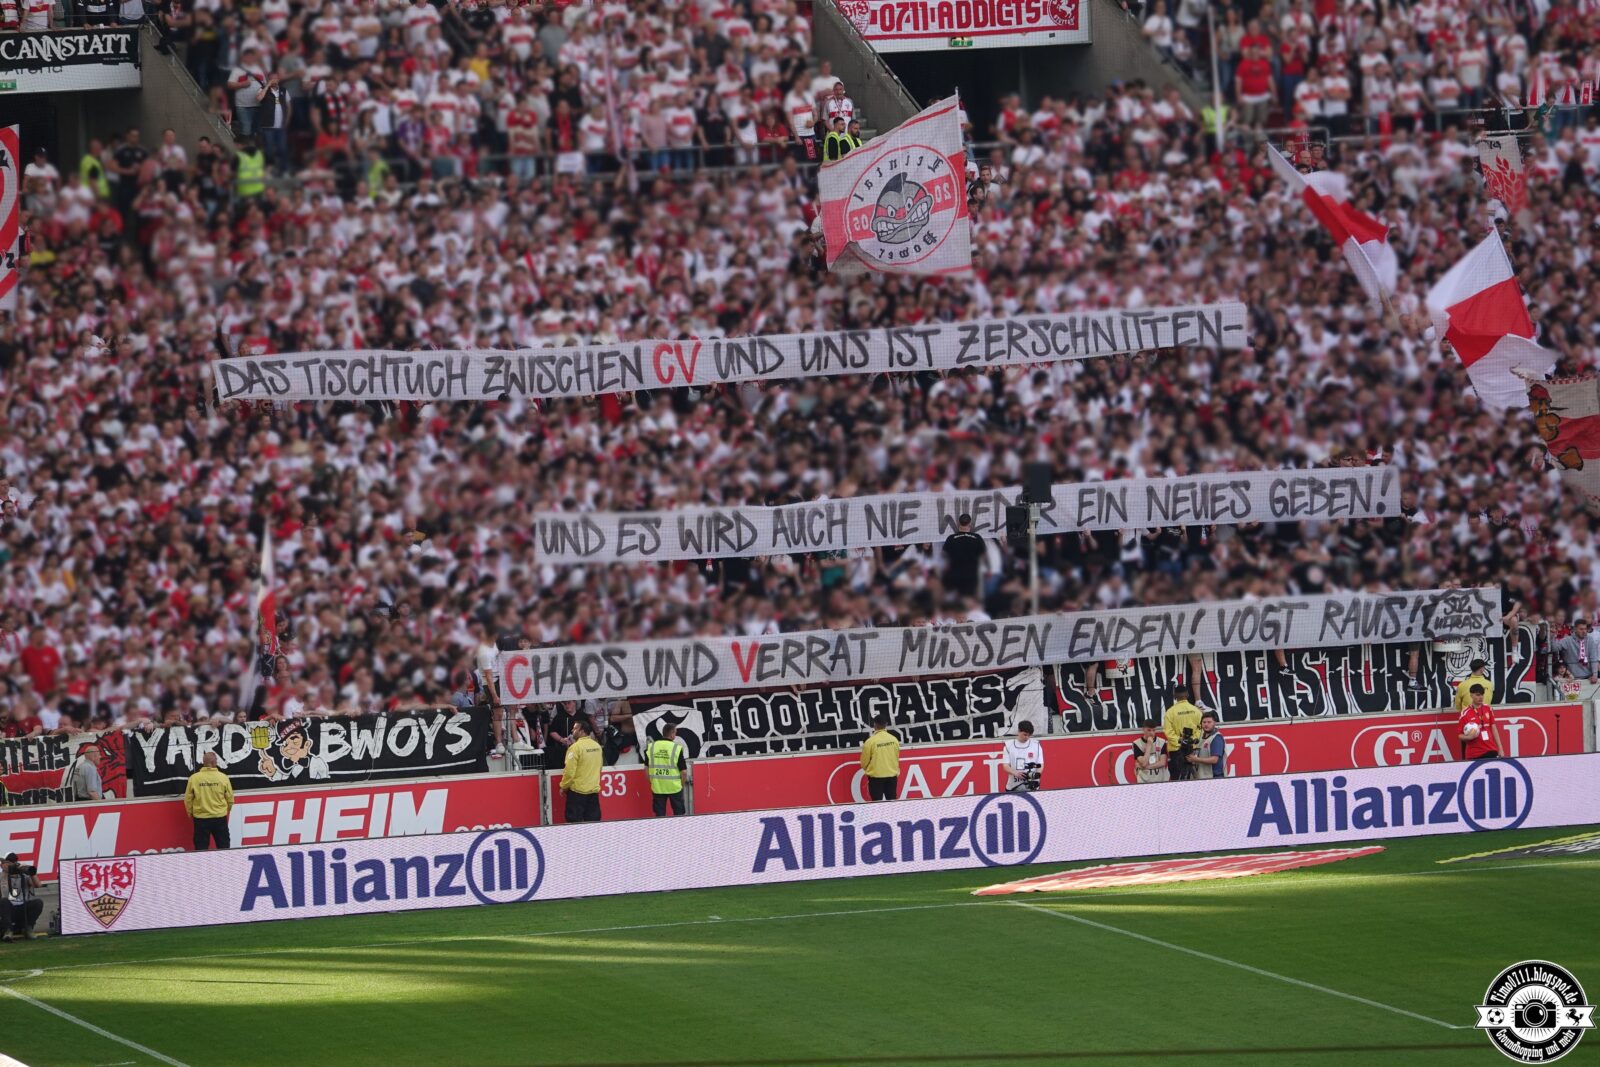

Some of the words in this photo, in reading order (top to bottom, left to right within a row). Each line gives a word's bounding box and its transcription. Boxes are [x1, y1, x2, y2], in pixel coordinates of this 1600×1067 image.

[0, 33, 131, 62] CANNSTATT
[218, 359, 291, 398] DAS
[295, 355, 469, 397] TISCHTUCH
[482, 346, 644, 395] ZWISCHEN
[652, 340, 701, 384] CV
[714, 337, 785, 380] UND
[799, 329, 870, 372] UNS
[886, 326, 941, 367] IST
[956, 309, 1244, 364] ZERSCHNITTEN-
[539, 514, 606, 556] UND
[616, 516, 662, 556] ES
[677, 510, 758, 554] WIRD
[772, 502, 849, 548] AUCH
[864, 499, 922, 540] NIE
[937, 490, 1058, 535] WIEDR
[1076, 485, 1128, 527] EIN
[1146, 479, 1252, 521] NEUES
[1269, 472, 1392, 518] GEBEN!
[505, 647, 629, 700] CHAOS
[642, 643, 719, 688] UND
[731, 630, 881, 682] VERRAT
[899, 621, 1052, 673] MÜSSEN
[1067, 606, 1206, 660] ENDEN!
[1216, 603, 1308, 648] VOGT
[1319, 594, 1425, 642] RAUS!
[696, 675, 1004, 742] HOOLIGANS
[135, 723, 250, 772] YARD
[320, 712, 473, 763] BWOYS
[228, 788, 449, 848] EHEIM
[1246, 775, 1460, 838] Allianz
[752, 809, 971, 874] Allianz
[79, 861, 133, 892] VfB
[240, 847, 467, 912] Allianz
